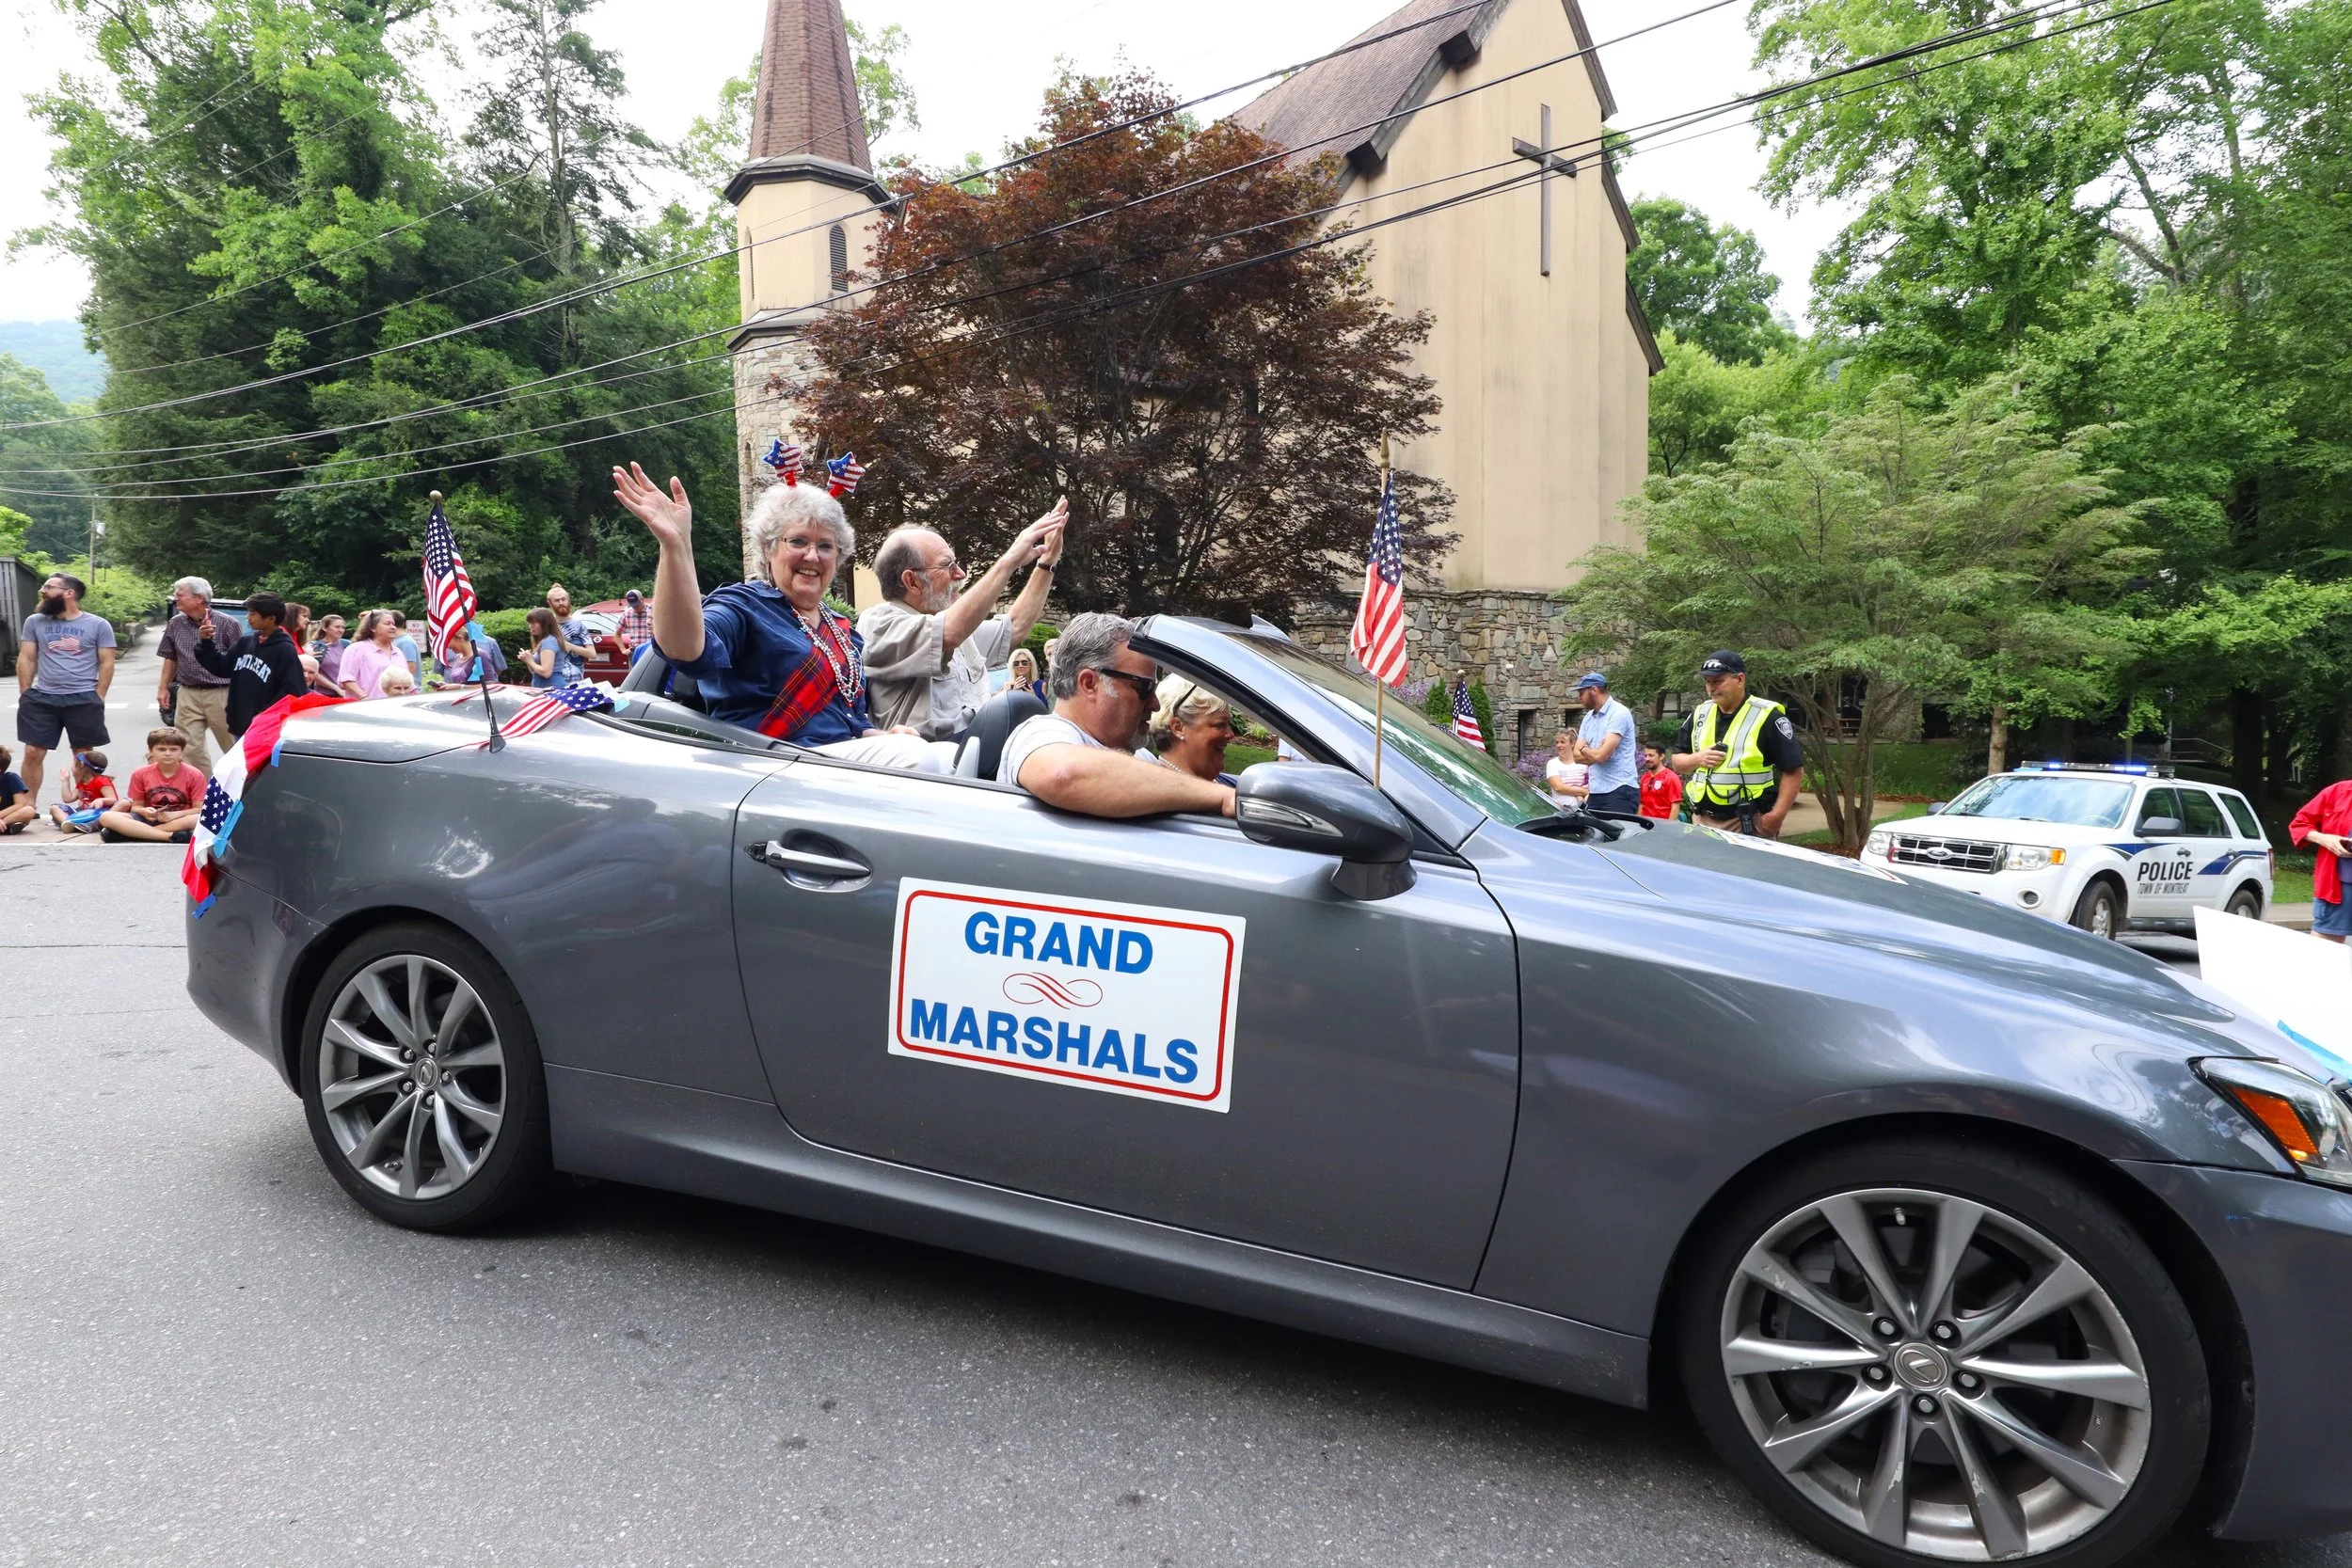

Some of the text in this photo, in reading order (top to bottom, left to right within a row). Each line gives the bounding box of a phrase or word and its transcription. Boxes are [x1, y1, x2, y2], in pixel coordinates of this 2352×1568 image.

[44, 626, 85, 636] OLD NAVY
[2137, 861, 2194, 882] POLICE
[2137, 883, 2153, 895] TOWN
[2154, 883, 2163, 895] OF
[964, 911, 1153, 974] GRAND
[910, 997, 1199, 1085] MARSHALS
